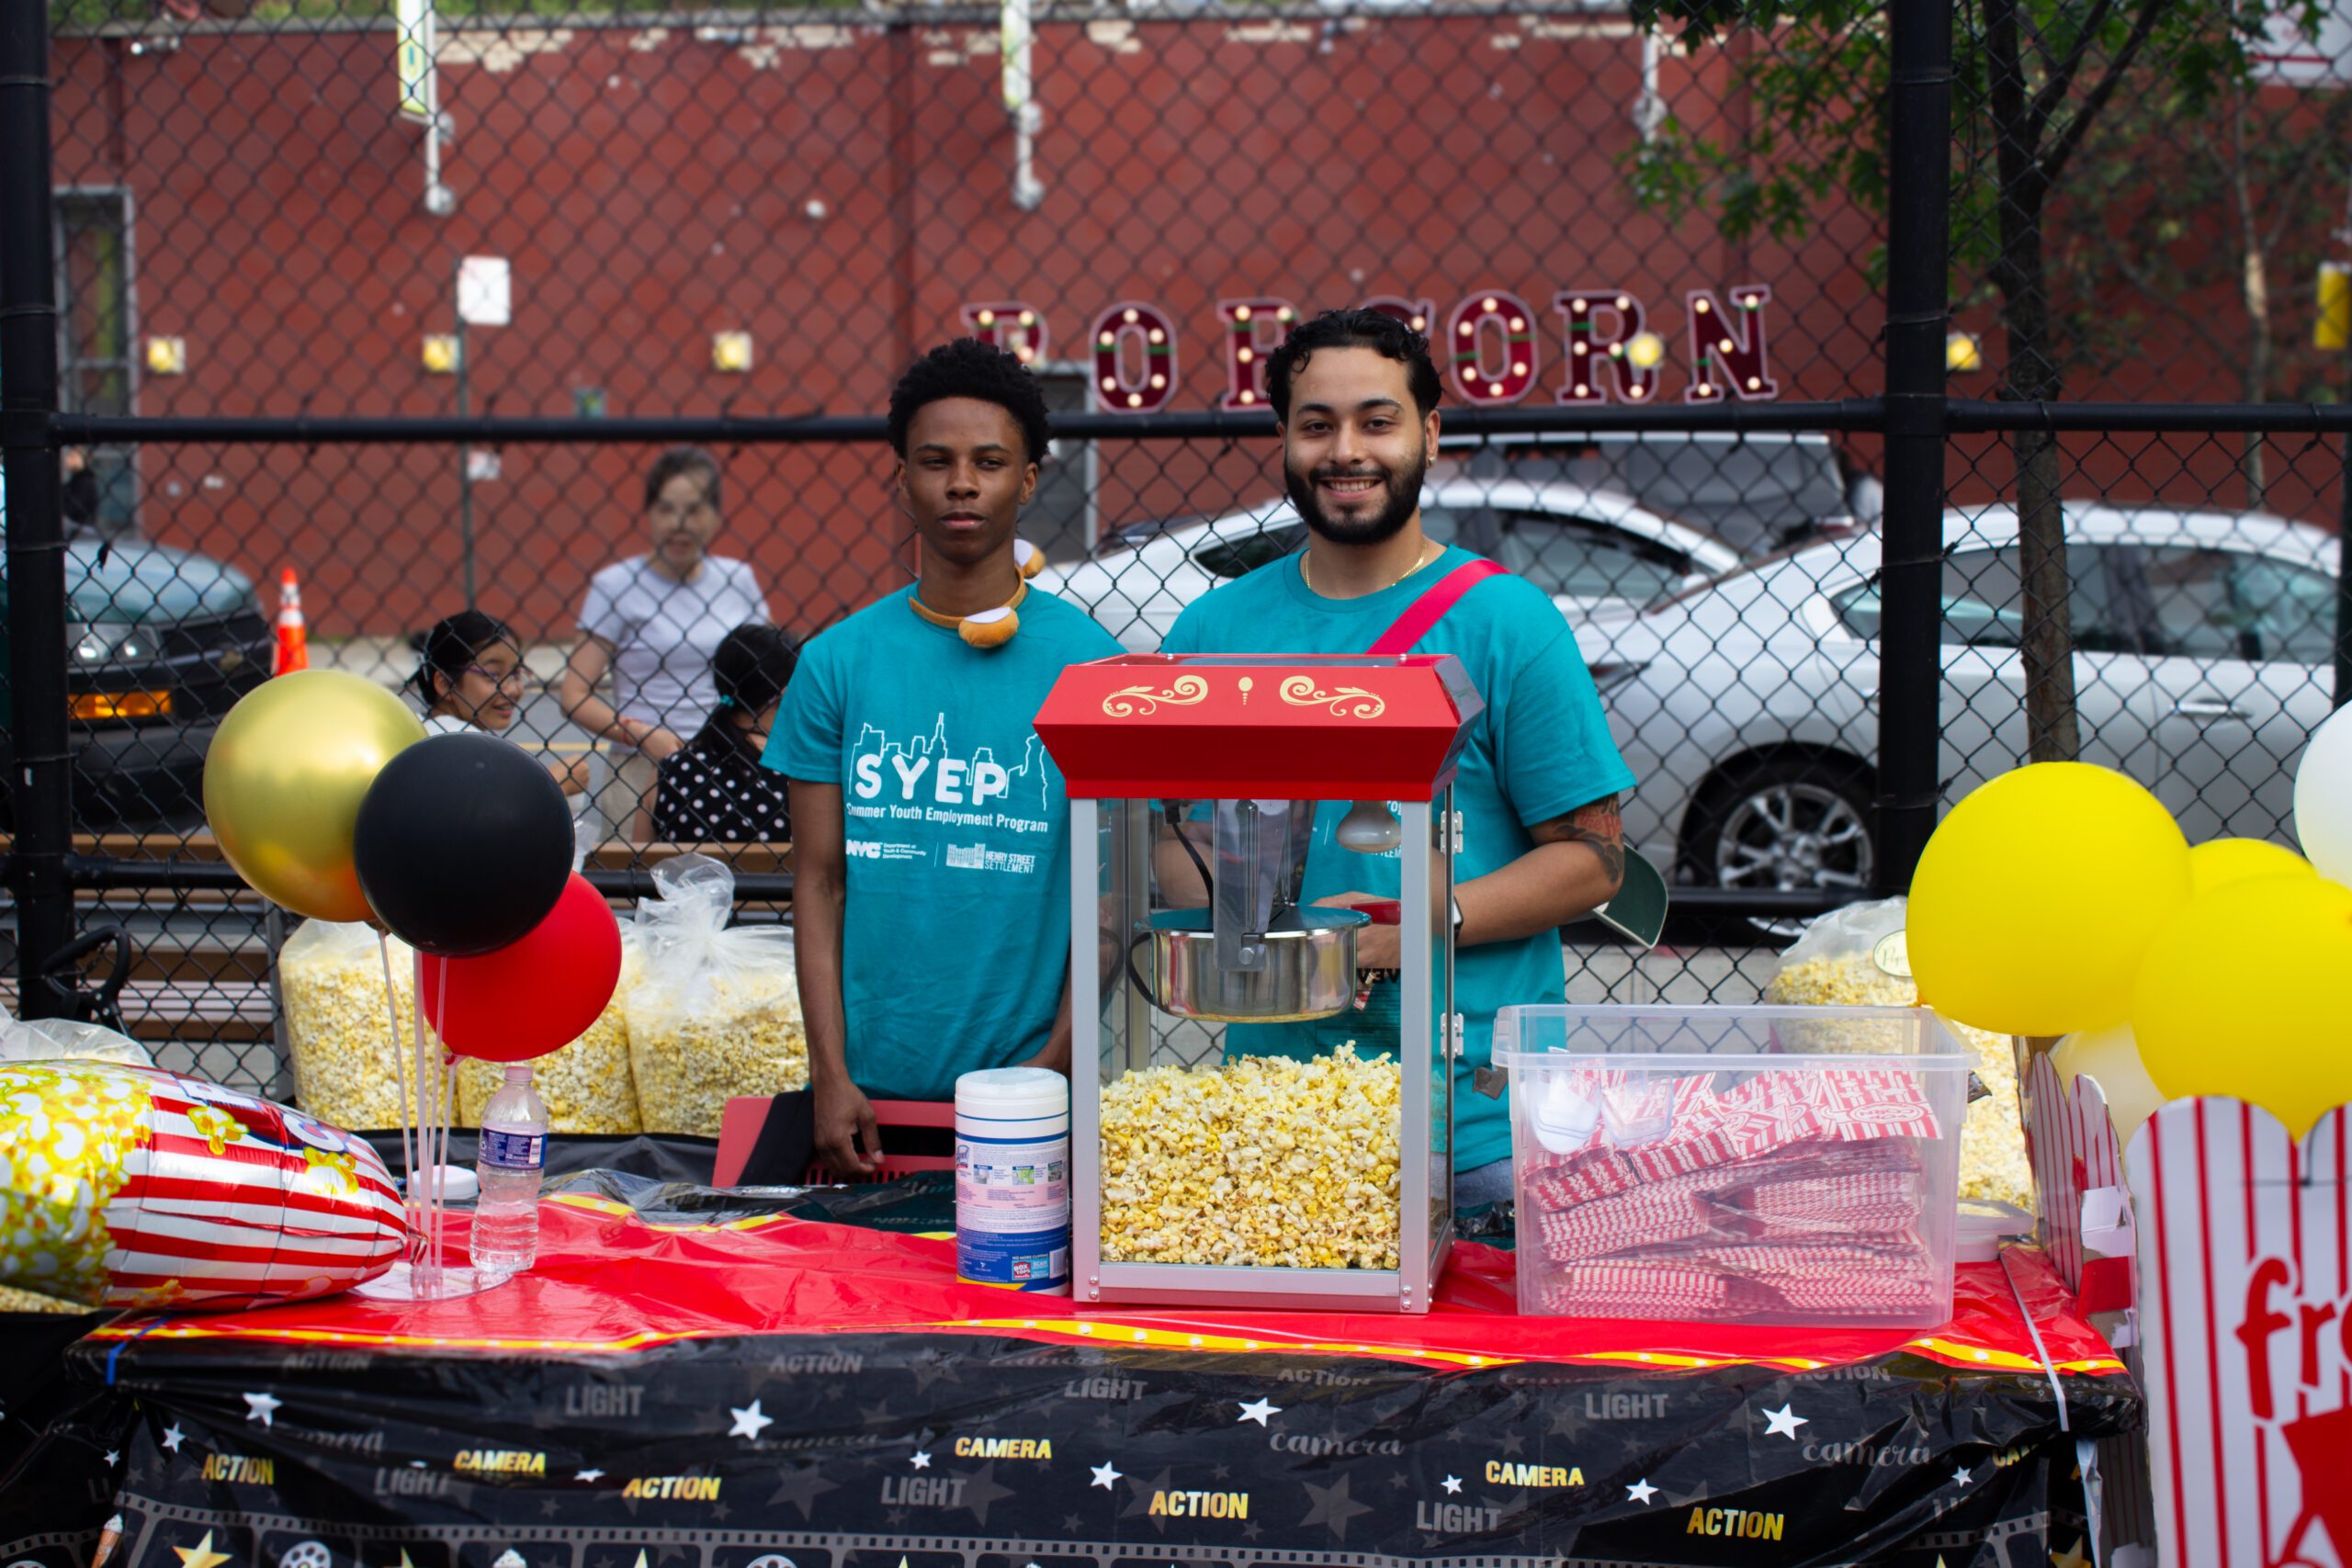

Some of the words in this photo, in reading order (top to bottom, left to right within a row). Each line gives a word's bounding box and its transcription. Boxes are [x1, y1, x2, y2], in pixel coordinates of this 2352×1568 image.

[855, 753, 1008, 806] SYEP
[846, 802, 886, 818] Summer
[889, 804, 922, 820] Youth
[925, 807, 993, 826] Employment
[996, 816, 1048, 832] Program
[845, 839, 881, 859] NYC
[985, 851, 1008, 862] HENRY
[1008, 853, 1035, 864] STREET
[984, 860, 1035, 874] SETTLEMENT
[769, 1353, 863, 1374] ACTION
[1277, 1367, 1372, 1387] ACTION
[564, 1385, 645, 1417] LIGHT
[1064, 1377, 1148, 1402] LIGHT
[1585, 1393, 1668, 1420] LIGHT
[955, 1437, 1052, 1461] CAMERA
[1270, 1431, 1407, 1458] camera
[1802, 1441, 1932, 1467] camera
[200, 1452, 275, 1485] ACTION
[454, 1449, 546, 1475] CAMERA
[1485, 1460, 1585, 1488] CAMERA
[622, 1475, 722, 1501] ACTION
[880, 1476, 967, 1508] LIGHT
[1148, 1489, 1250, 1520] ACTION
[1416, 1500, 1502, 1534] LIGHT
[1687, 1506, 1785, 1541] ACTION
